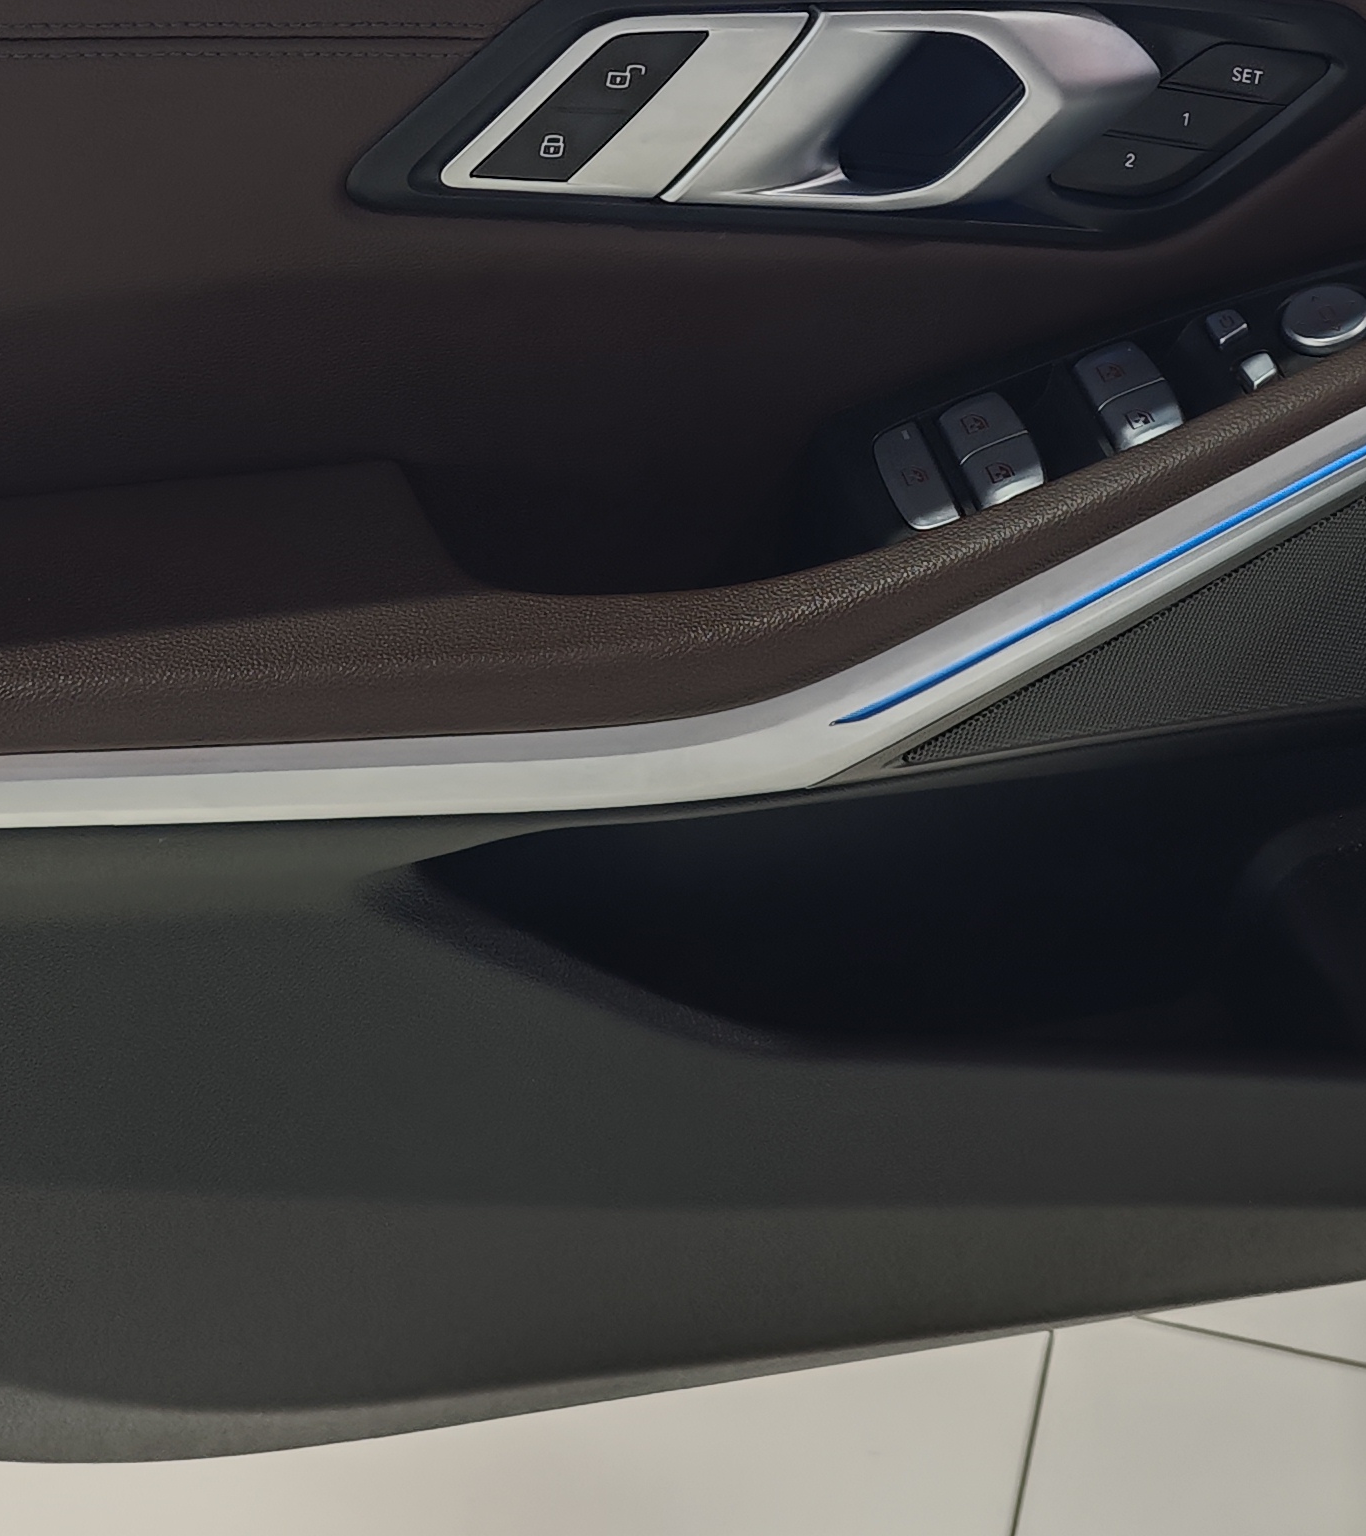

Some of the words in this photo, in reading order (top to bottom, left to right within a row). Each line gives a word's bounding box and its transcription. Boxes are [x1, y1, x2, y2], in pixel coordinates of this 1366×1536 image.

[1232, 66, 1264, 85] SET
[1182, 113, 1190, 127] 1
[1124, 153, 1136, 167] 2
